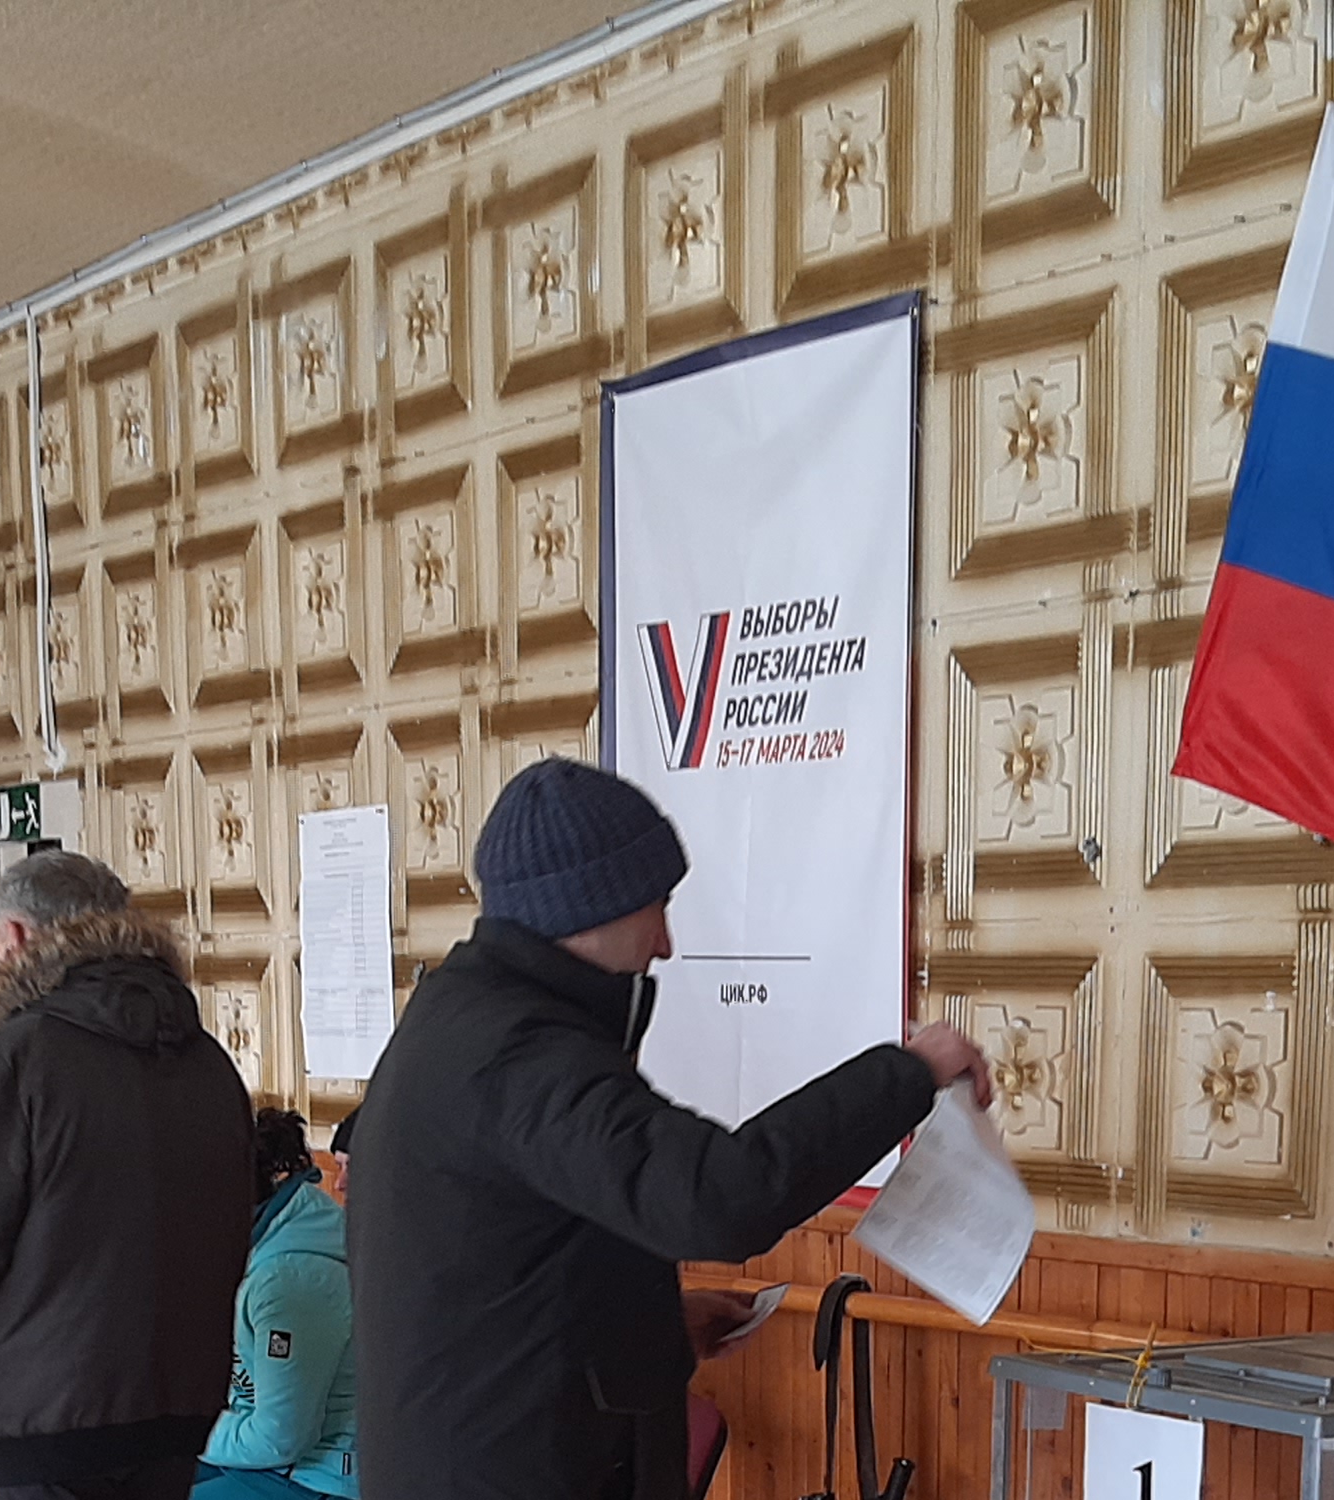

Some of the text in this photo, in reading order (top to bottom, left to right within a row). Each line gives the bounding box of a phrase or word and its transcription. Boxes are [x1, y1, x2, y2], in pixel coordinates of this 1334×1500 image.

[739, 595, 840, 641] ВЫБОРЫ
[730, 636, 867, 686] ПРЕЗИДЕНТА
[723, 690, 808, 731] РОССИИ
[756, 732, 808, 766] МАРТА
[808, 728, 845, 761] 2024
[720, 983, 768, 1008] ЦИК.РФ
